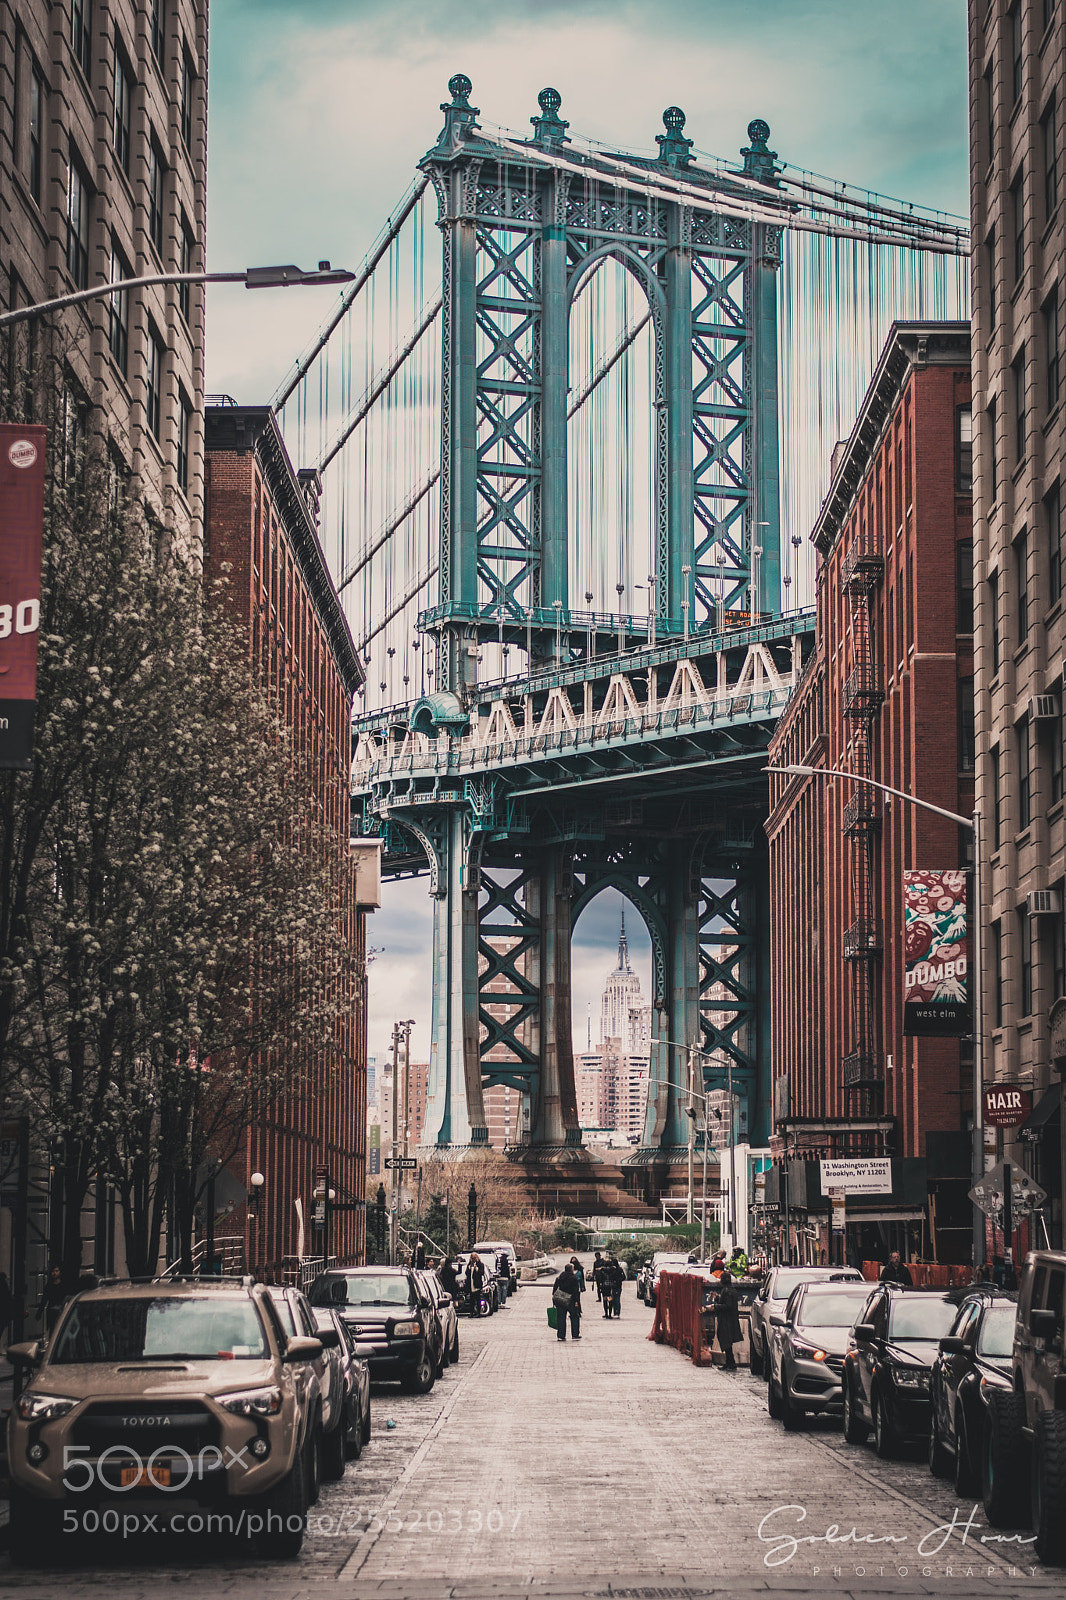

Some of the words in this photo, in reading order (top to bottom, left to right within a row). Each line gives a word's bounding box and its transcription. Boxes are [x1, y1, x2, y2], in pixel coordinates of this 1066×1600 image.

[905, 959, 967, 988] DUMBO
[916, 1010, 936, 1018] west
[940, 1010, 956, 1018] elm
[986, 1091, 1022, 1110] HAIR
[122, 1416, 171, 1426] TOYOTA
